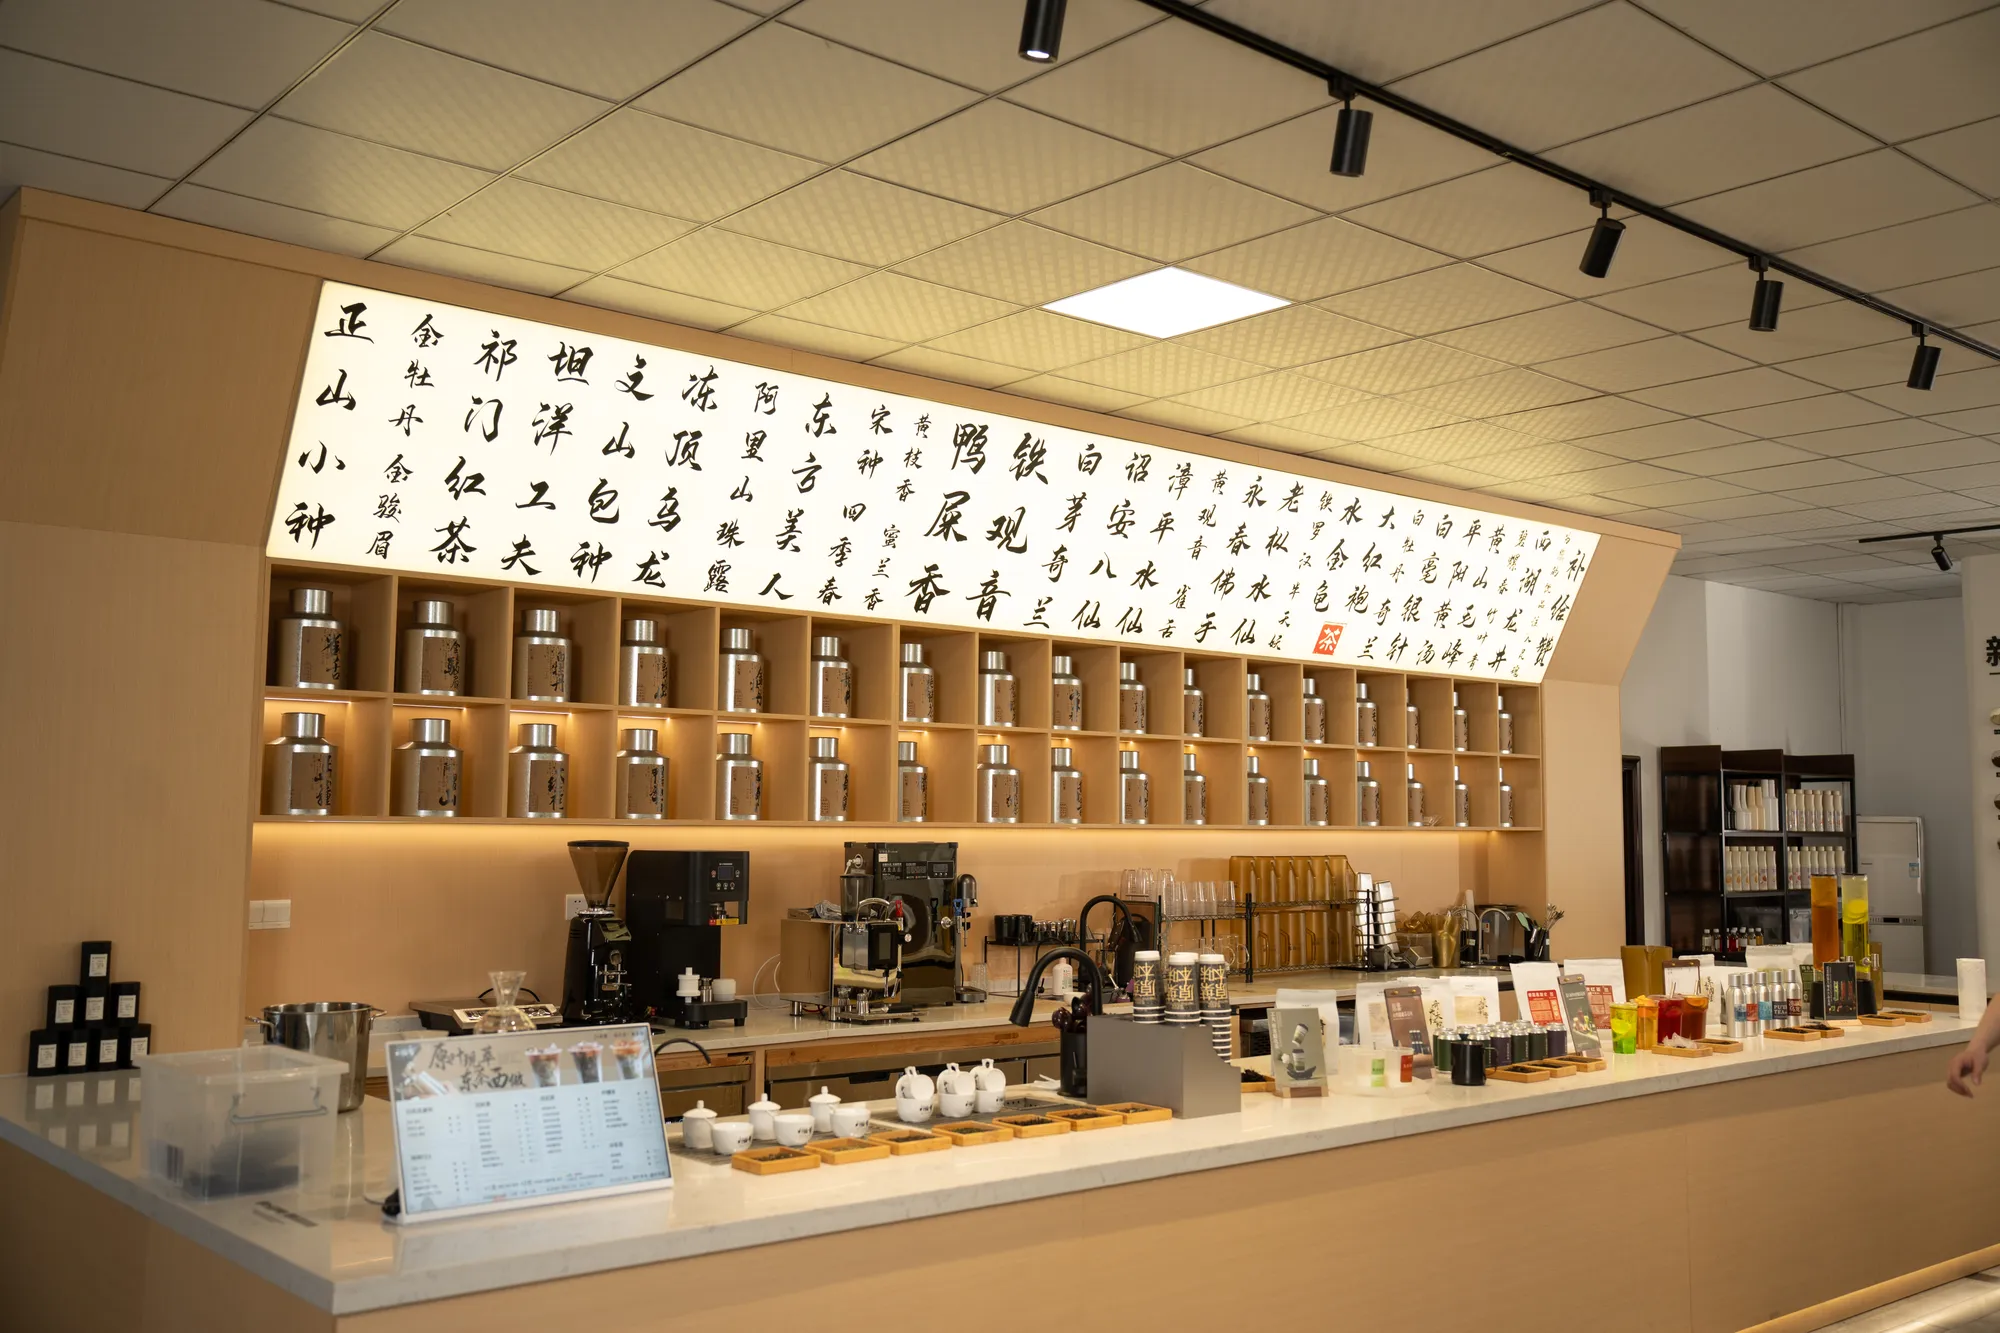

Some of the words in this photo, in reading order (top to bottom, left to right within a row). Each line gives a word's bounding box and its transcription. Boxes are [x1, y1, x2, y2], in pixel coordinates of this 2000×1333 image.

[284, 302, 375, 550] 正山小种
[428, 329, 518, 565] 祁门红茶
[500, 341, 594, 576] 坦洋工夫
[569, 353, 655, 583] 文山包种
[631, 364, 719, 589] 冻顶乌龙
[757, 391, 838, 601] 东方美人
[904, 422, 990, 615] 鸭屎香
[965, 431, 1049, 623] 铁观音
[1022, 443, 1103, 629] 白芽奇兰
[1114, 462, 1194, 636] 漳平水仙
[1344, 505, 1396, 614] 大红袍
